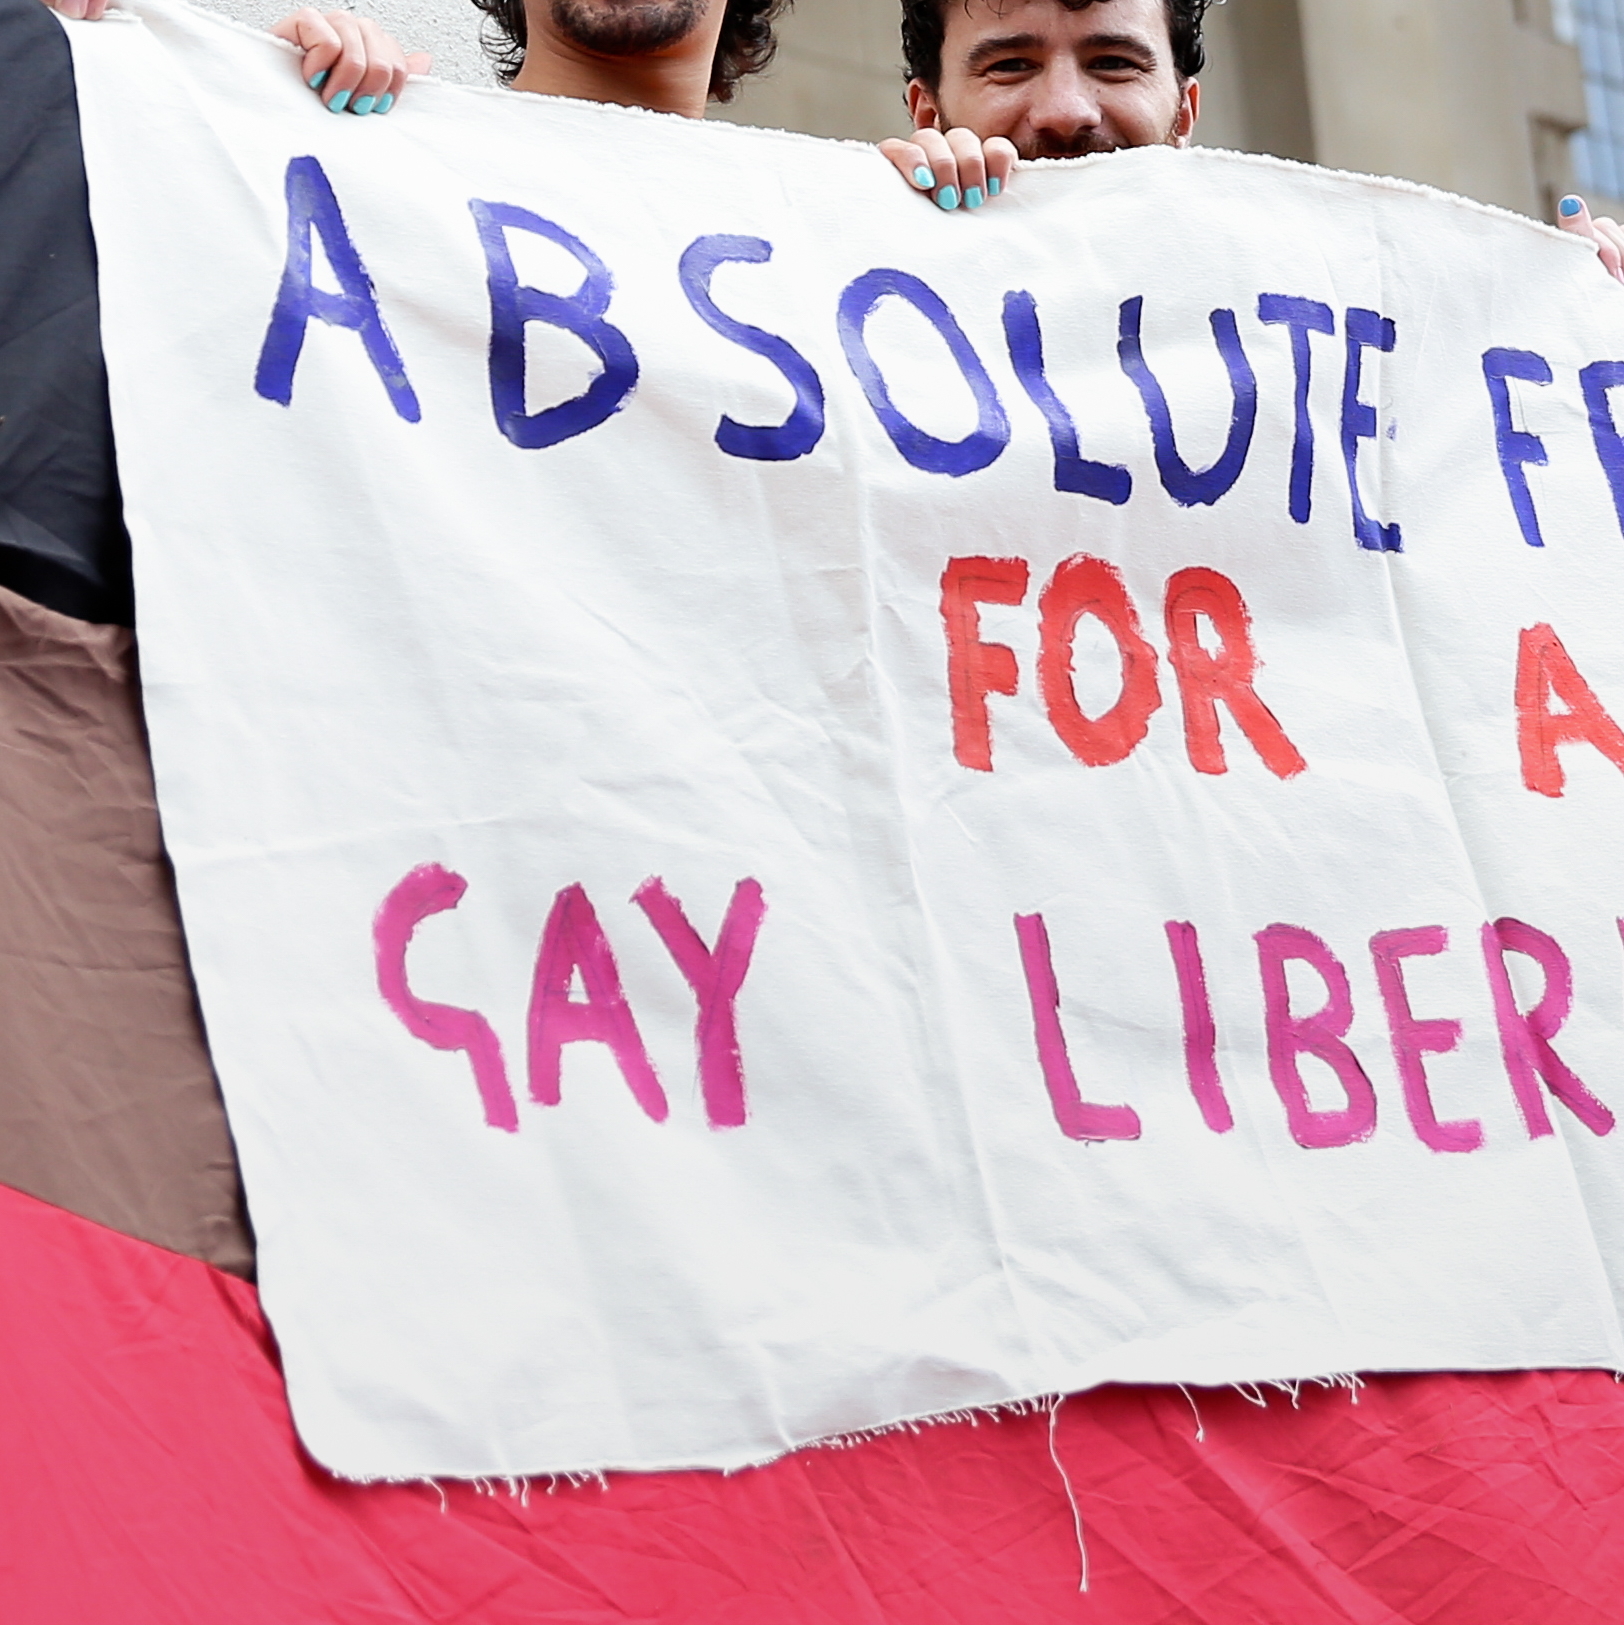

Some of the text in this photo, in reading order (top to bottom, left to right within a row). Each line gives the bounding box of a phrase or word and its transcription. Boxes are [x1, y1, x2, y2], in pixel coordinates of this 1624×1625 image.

[255, 155, 1403, 553] ABSOLUTE
[940, 552, 1308, 780] FOR
[372, 862, 769, 1134] GAY
